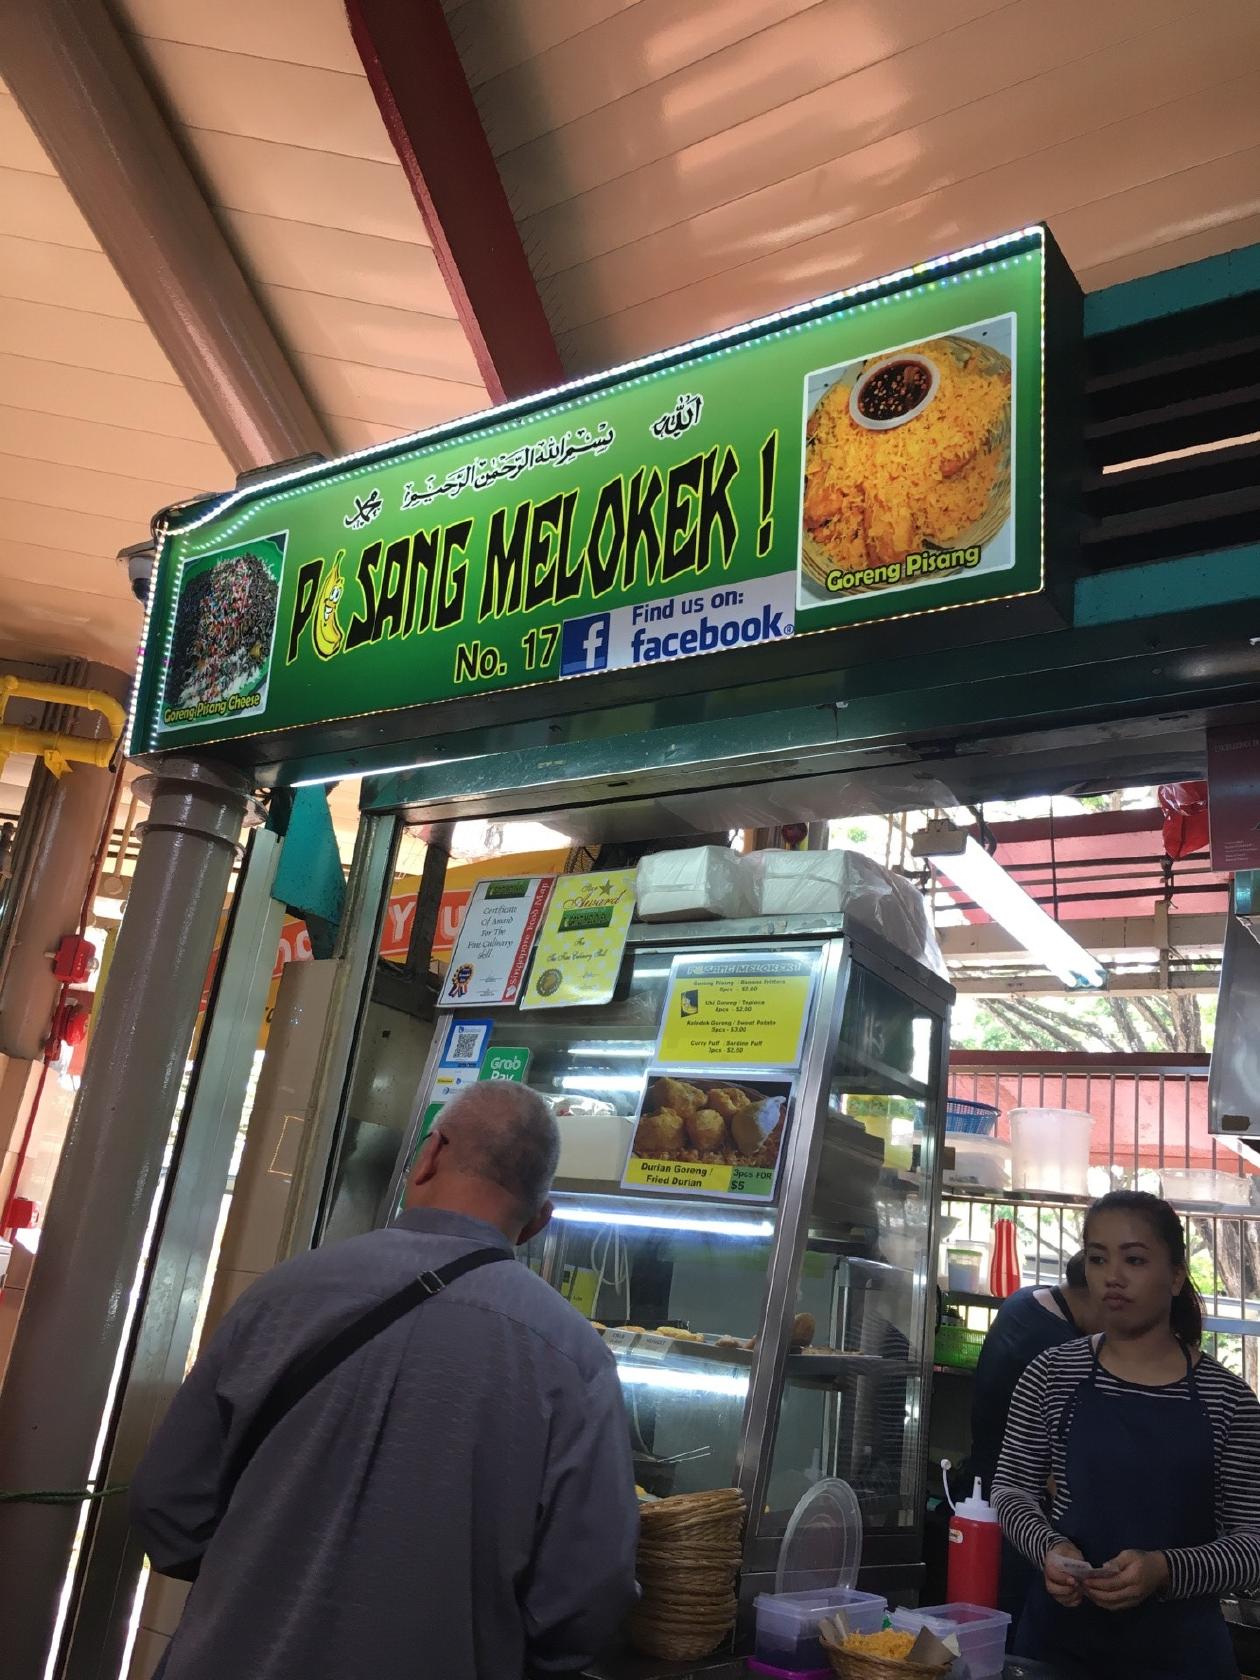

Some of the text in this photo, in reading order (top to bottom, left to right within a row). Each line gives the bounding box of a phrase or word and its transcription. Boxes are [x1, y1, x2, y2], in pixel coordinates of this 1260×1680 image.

[478, 444, 739, 624] MELOKEK
[826, 546, 982, 592] Goreng Pisang
[632, 590, 744, 626] Find us on:
[454, 623, 561, 684] No. 17
[164, 693, 262, 723] Goreng Pisang Cheese
[490, 1056, 521, 1070] Grab
[641, 1162, 671, 1173] Durian
[674, 1164, 707, 1177] Goreng
[756, 1172, 773, 1180] FOR
[646, 1174, 702, 1188] Fried Durian
[730, 1181, 745, 1191] $5
